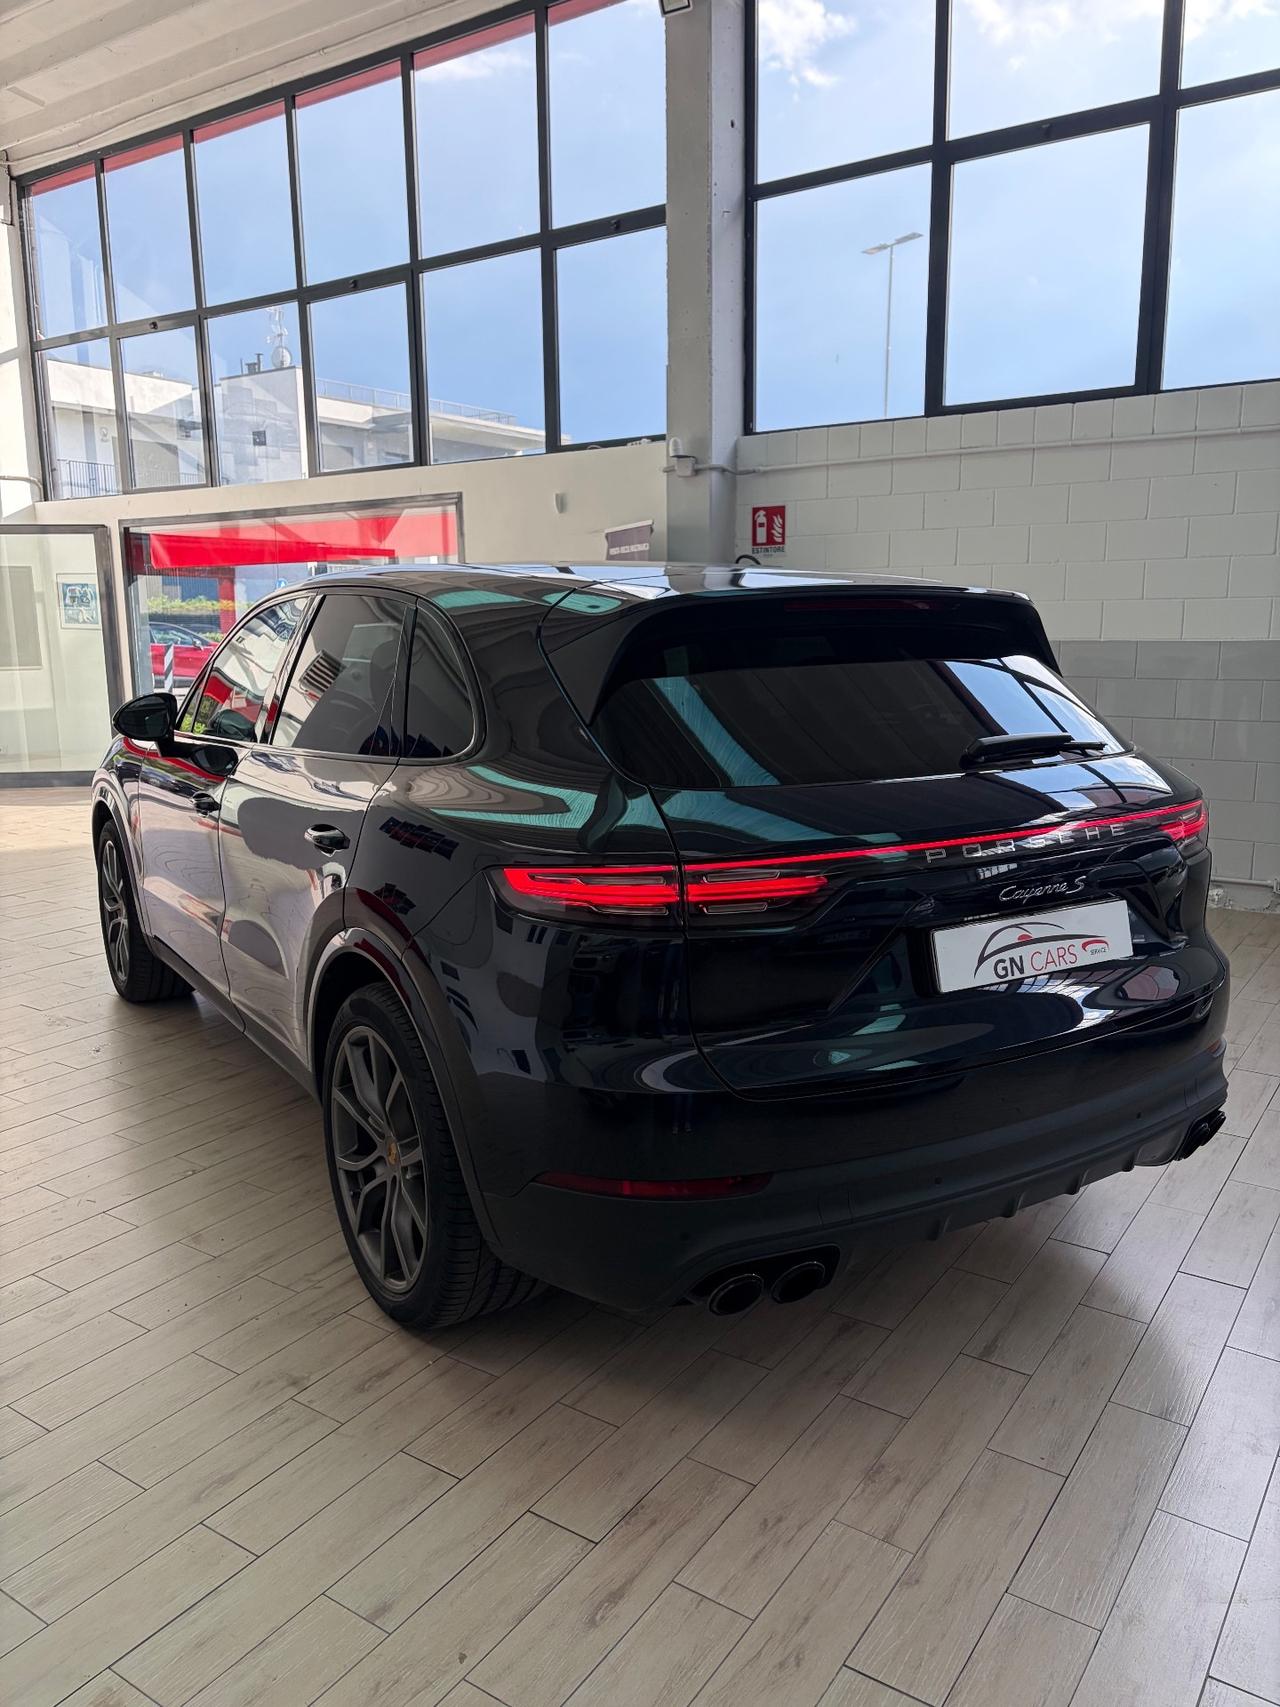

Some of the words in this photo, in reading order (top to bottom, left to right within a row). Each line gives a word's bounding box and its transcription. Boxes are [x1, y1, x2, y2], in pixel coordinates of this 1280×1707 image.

[925, 823, 1125, 863] PORSCHE
[999, 882, 1068, 904] Cayenne
[1065, 875, 1086, 894] S
[993, 955, 1025, 979] GN
[1030, 944, 1078, 971] CARS
